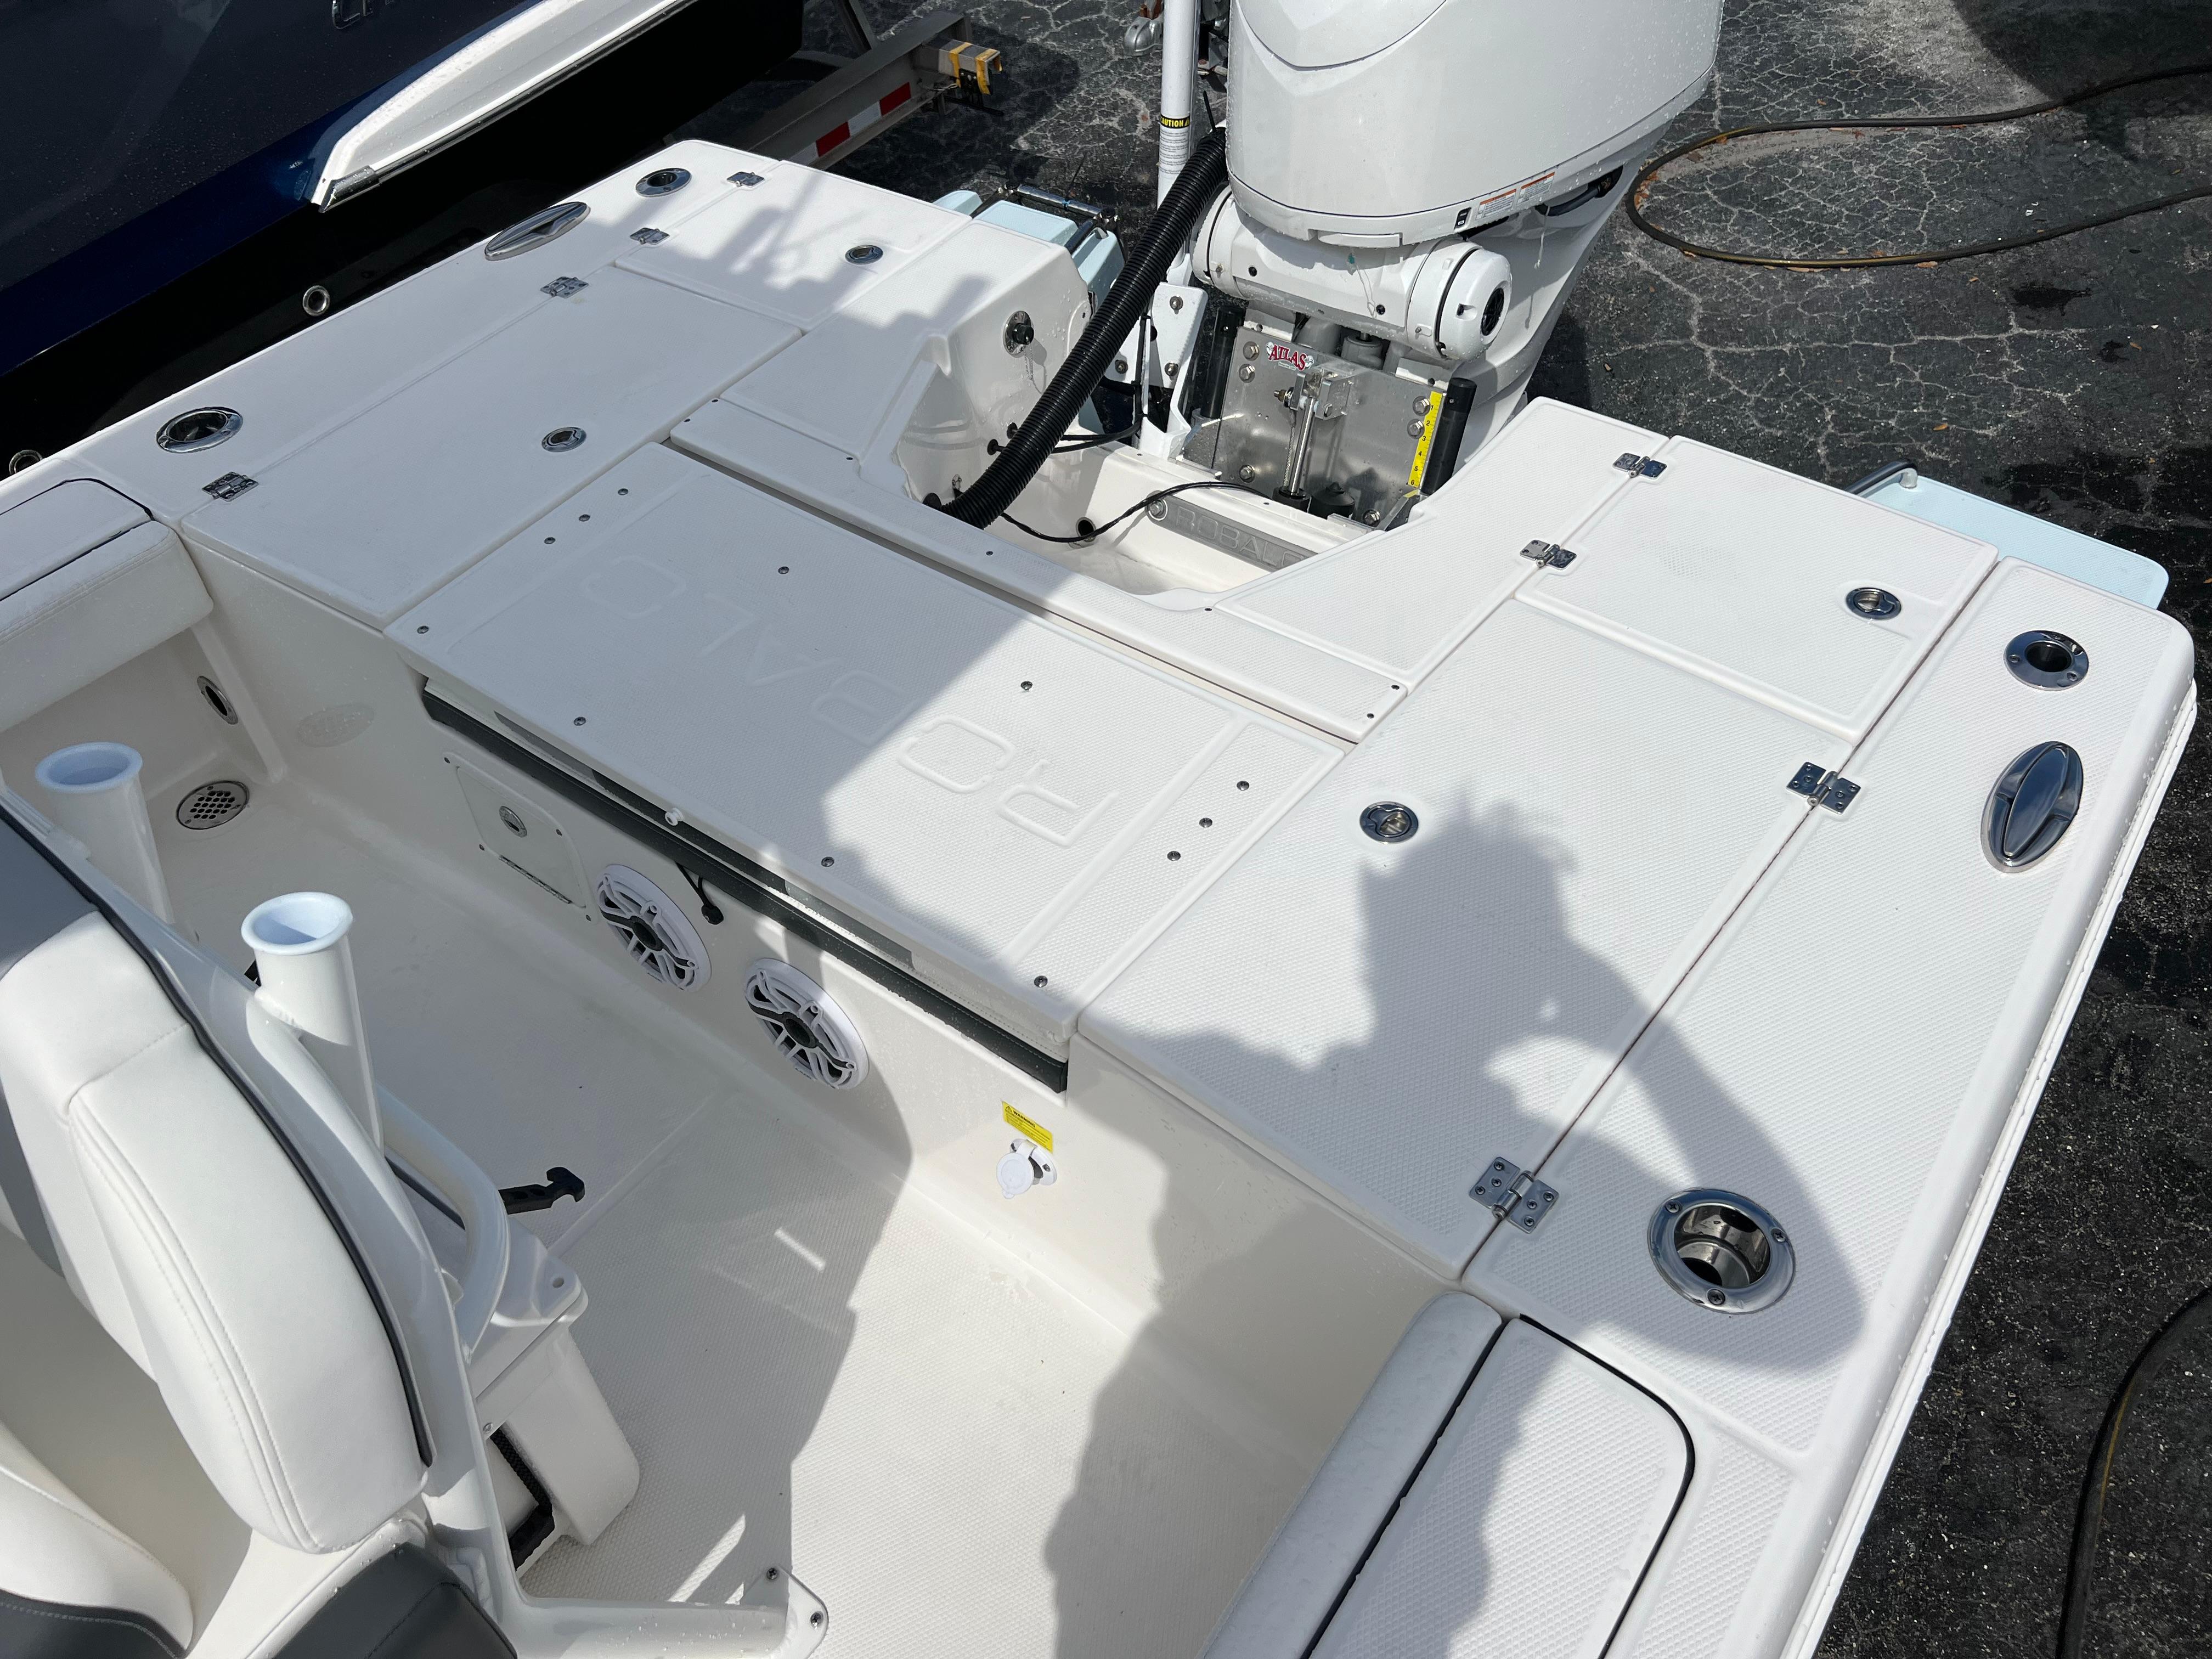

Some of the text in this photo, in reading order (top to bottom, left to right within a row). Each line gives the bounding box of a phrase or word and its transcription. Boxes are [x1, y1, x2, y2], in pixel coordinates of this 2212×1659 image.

[1268, 344, 1307, 371] ATLAS
[580, 554, 1120, 849] ROBALO
[1013, 1110, 1036, 1128] WARNING
